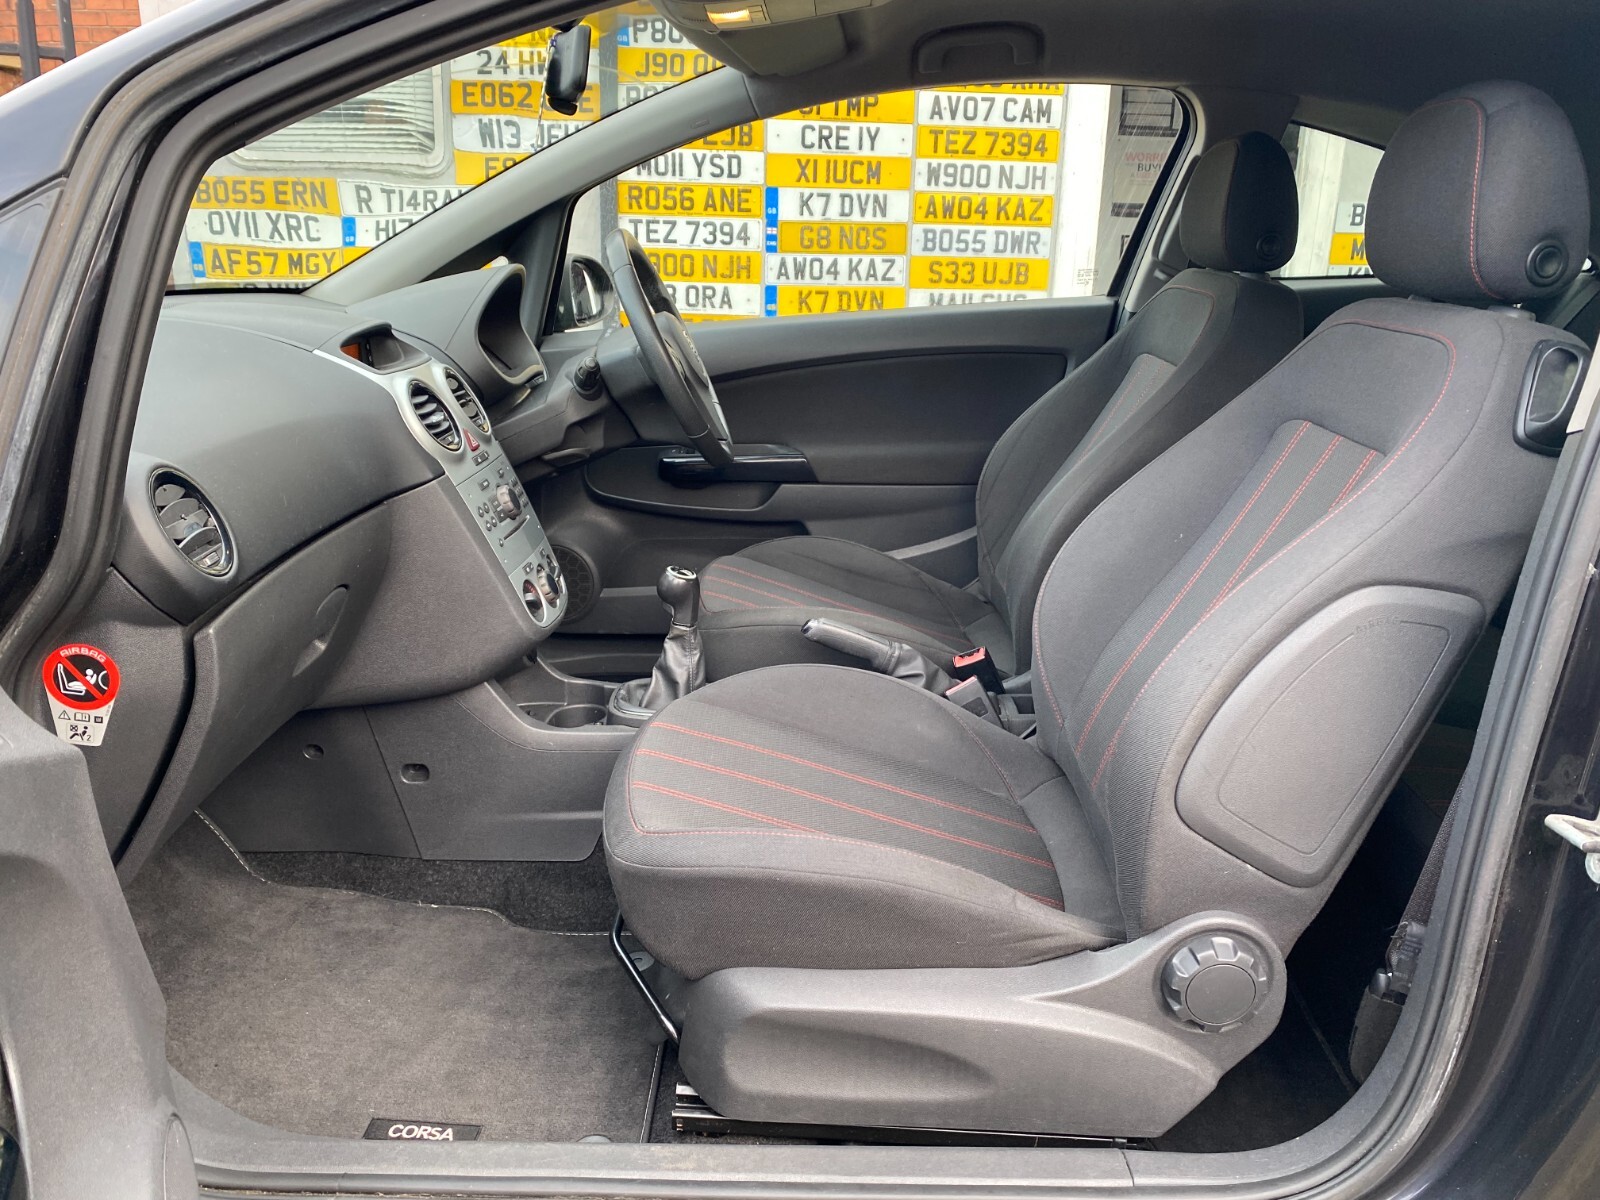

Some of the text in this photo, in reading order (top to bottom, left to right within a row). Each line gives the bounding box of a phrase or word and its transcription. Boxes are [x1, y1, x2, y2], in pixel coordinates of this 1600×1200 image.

[476, 50, 509, 75] 24
[635, 52, 685, 77] J90
[1003, 97, 1053, 124] CAM
[801, 124, 849, 150] CRE
[929, 130, 1049, 158] TEZ 7394
[692, 153, 742, 179] YSD
[926, 162, 1047, 190] W900 NJH
[273, 181, 328, 209] ERN
[354, 184, 374, 214] R
[703, 187, 752, 213] ANE
[799, 192, 888, 218] K7 DVN
[996, 196, 1045, 222] KAZ
[268, 213, 322, 243] XRC
[628, 219, 751, 247] TEZ 7394
[800, 225, 832, 250] G8
[993, 230, 1041, 255] DWR
[210, 248, 336, 278] AF57 MGY
[702, 254, 752, 281] NJH
[848, 258, 896, 282] KAZ
[928, 260, 1030, 286] S33 UJB
[797, 290, 885, 314] K7 DVN
[59, 646, 107, 664] AIRBAG
[388, 1124, 453, 1142] CORSA
